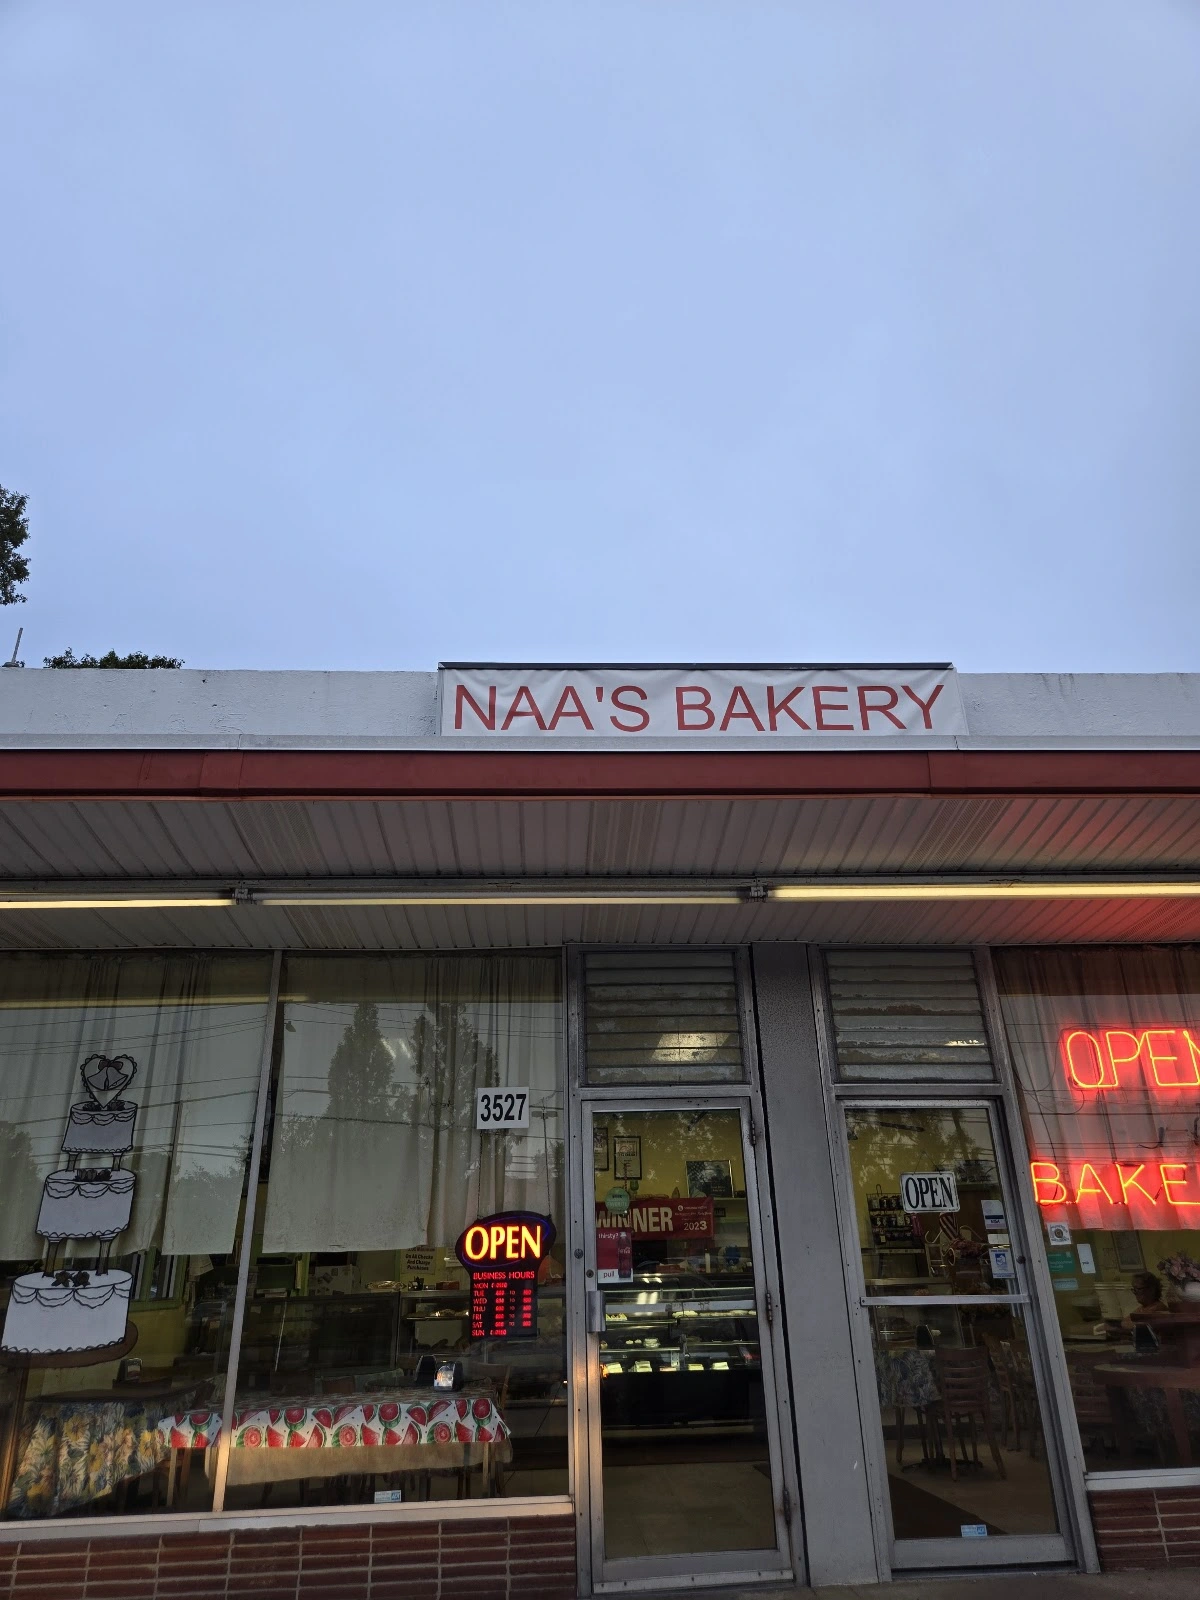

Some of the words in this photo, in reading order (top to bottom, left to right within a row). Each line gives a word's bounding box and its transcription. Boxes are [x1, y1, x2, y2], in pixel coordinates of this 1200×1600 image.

[454, 684, 650, 733] NAA'S
[675, 684, 945, 733] BAKERY
[480, 1093, 527, 1122] 3527
[905, 1176, 954, 1209] OPEN
[683, 1220, 708, 1231] 2023
[464, 1225, 541, 1260] OPEN
[473, 1271, 506, 1280] BUSINESS
[508, 1271, 535, 1279] HOURS
[603, 1270, 615, 1279] pull
